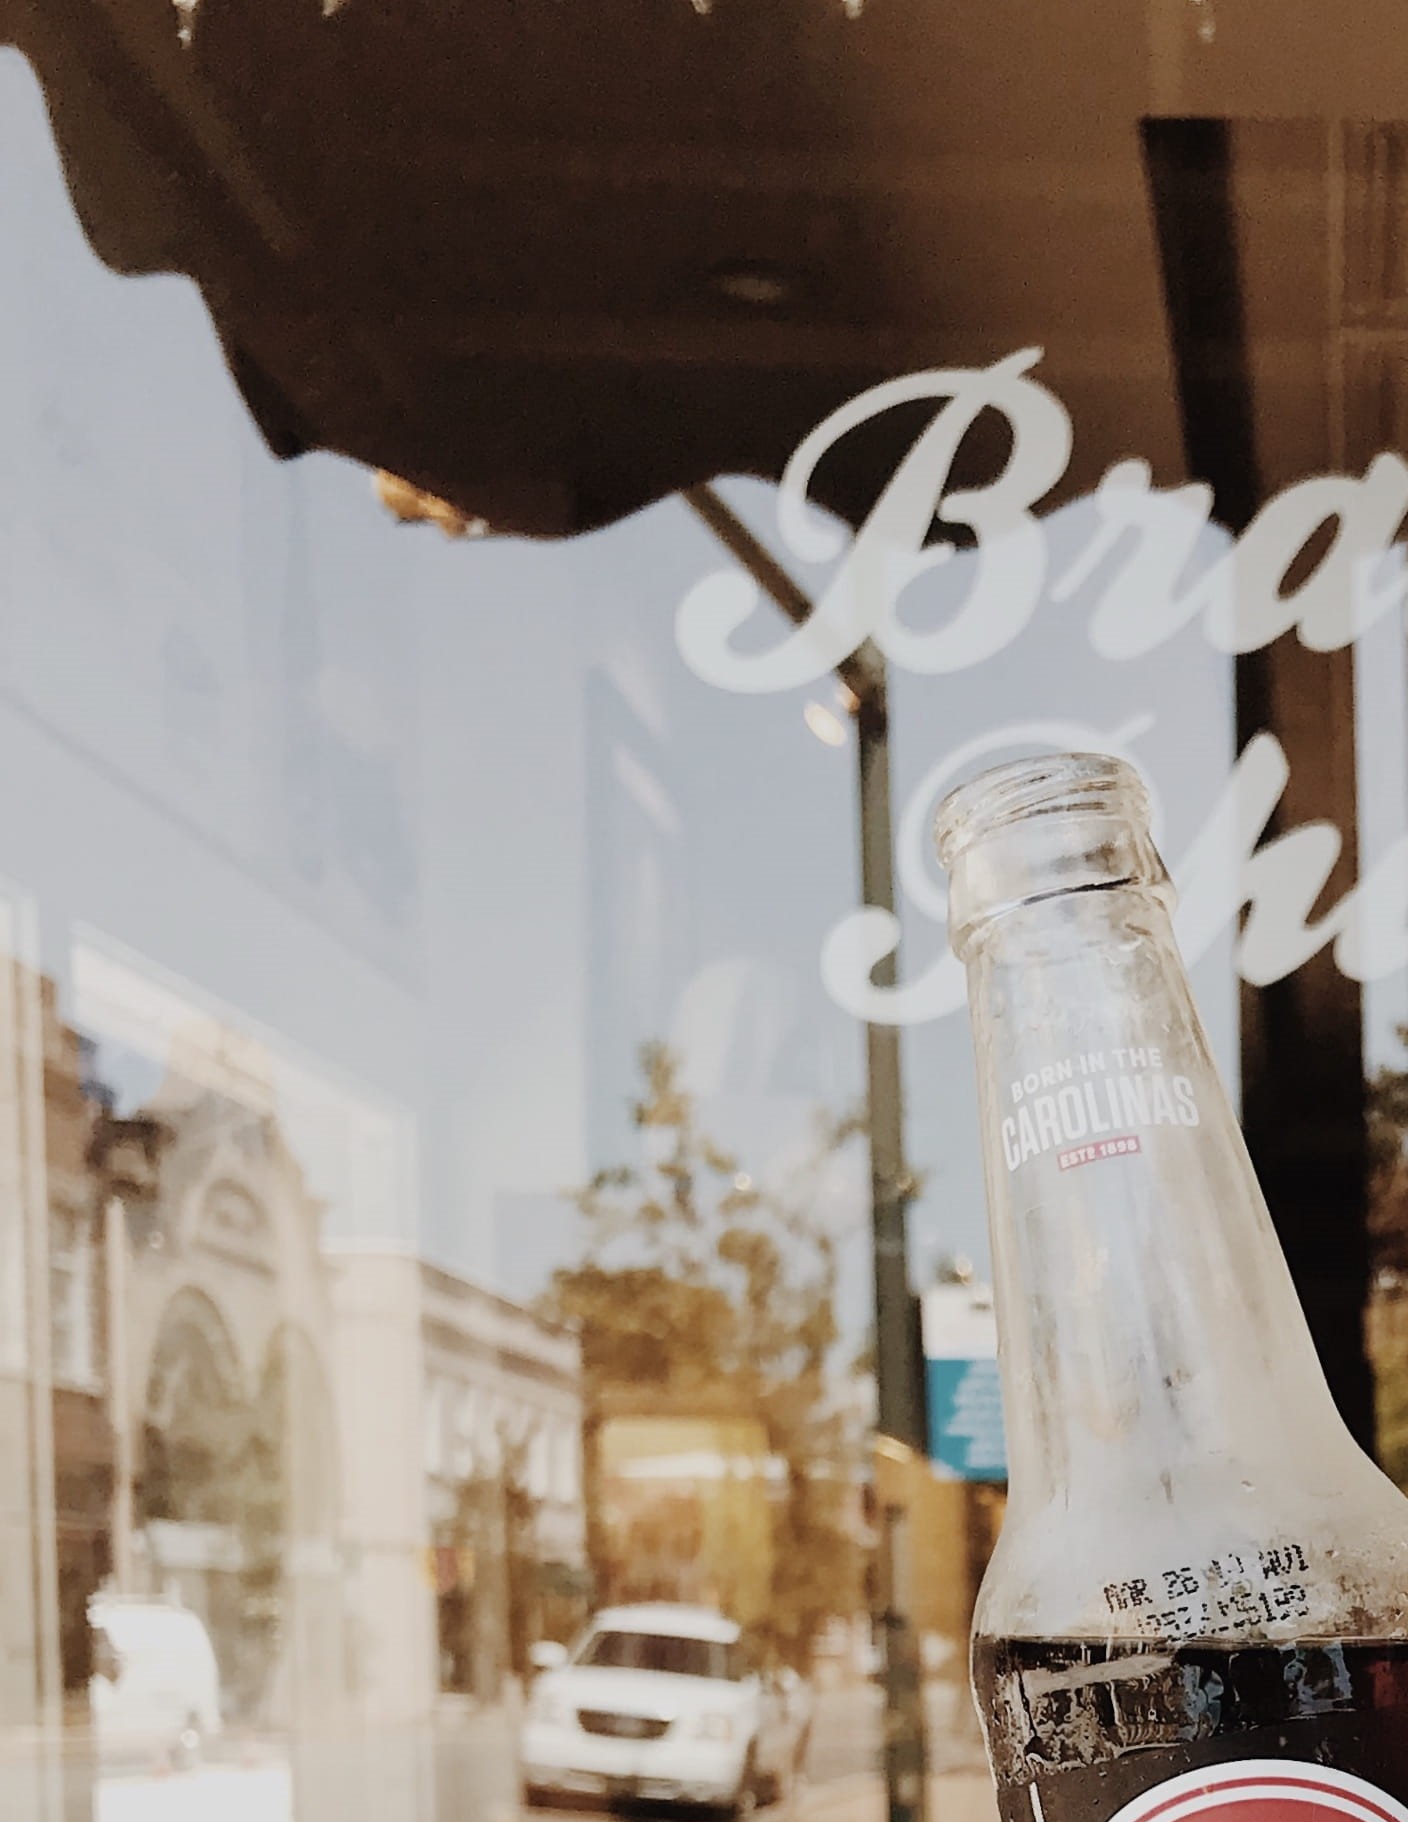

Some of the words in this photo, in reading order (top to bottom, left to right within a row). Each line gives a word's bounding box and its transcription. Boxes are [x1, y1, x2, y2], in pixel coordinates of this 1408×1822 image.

[1010, 1058, 1073, 1104] BORN
[1079, 1050, 1106, 1075] IN
[1111, 1047, 1163, 1069] THE
[1001, 1073, 1200, 1173] CAROLINAS
